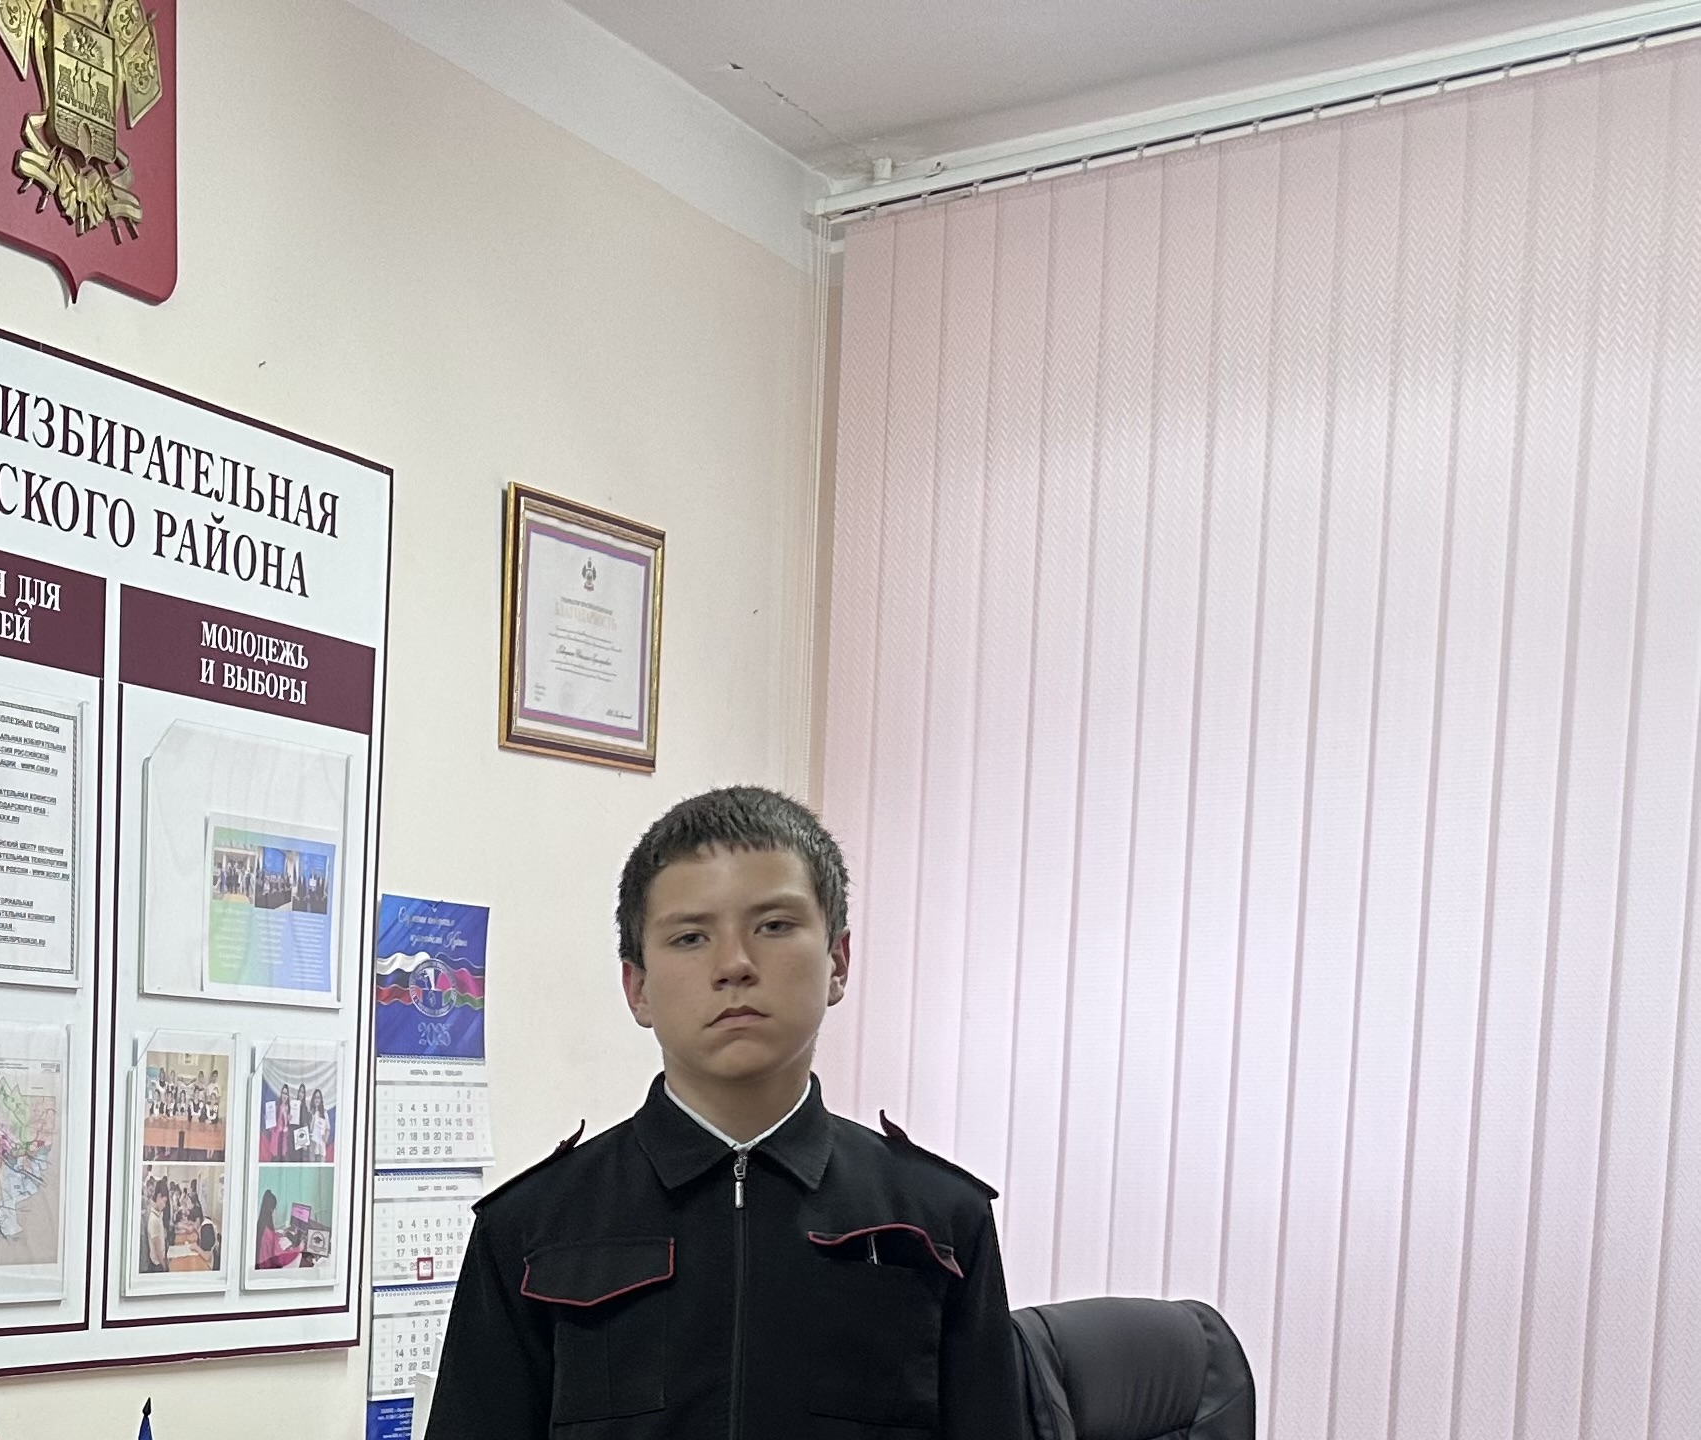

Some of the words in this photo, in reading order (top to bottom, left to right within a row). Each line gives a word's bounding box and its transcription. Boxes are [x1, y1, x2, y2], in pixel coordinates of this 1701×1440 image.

[152, 508, 311, 598] РАЙОНА
[15, 575, 62, 612] ДЛЯ
[200, 620, 309, 670] МОЛОДЕЖЬ
[199, 658, 216, 685] И
[222, 662, 308, 705] ВЫБОРЫ
